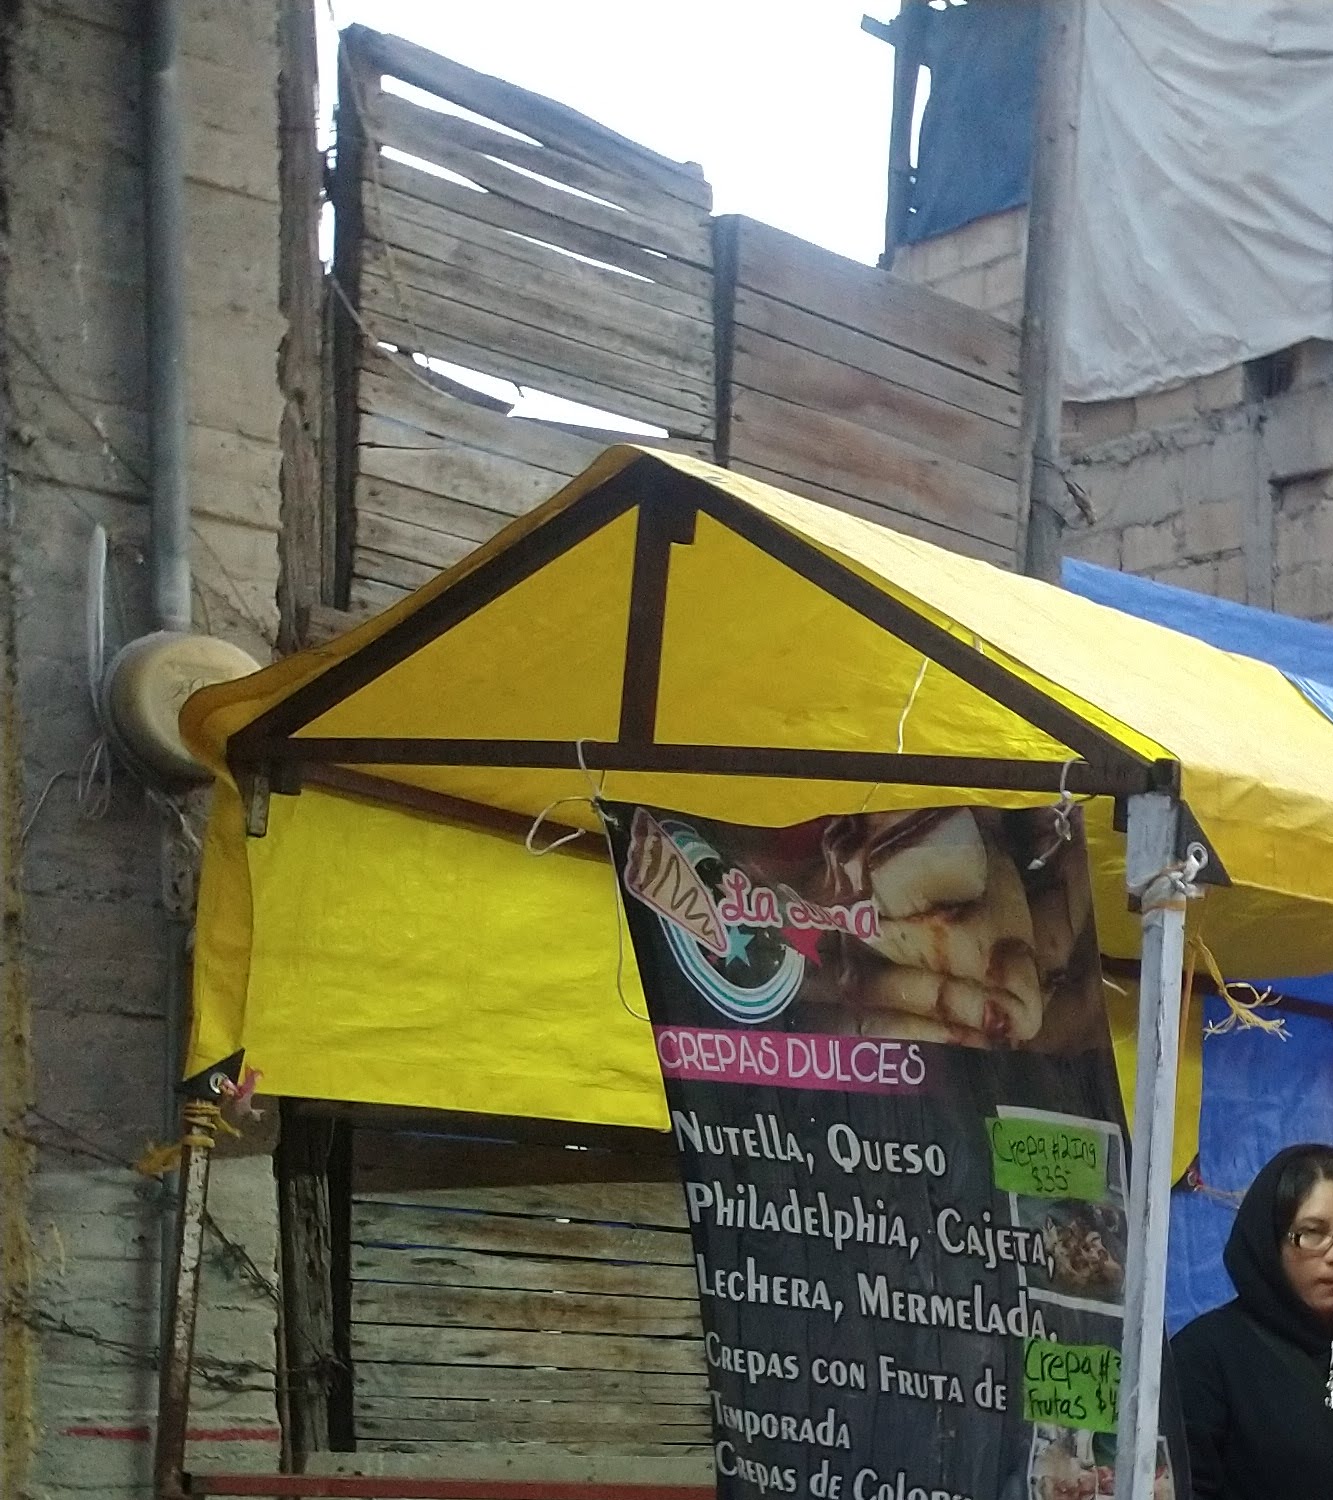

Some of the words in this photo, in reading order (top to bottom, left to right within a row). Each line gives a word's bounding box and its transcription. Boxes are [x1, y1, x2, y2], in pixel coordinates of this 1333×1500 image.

[719, 868, 783, 927] La
[659, 1031, 781, 1078] CREPAS
[787, 1039, 926, 1087] DULCES
[1024, 1339, 1097, 1390] Crepa
